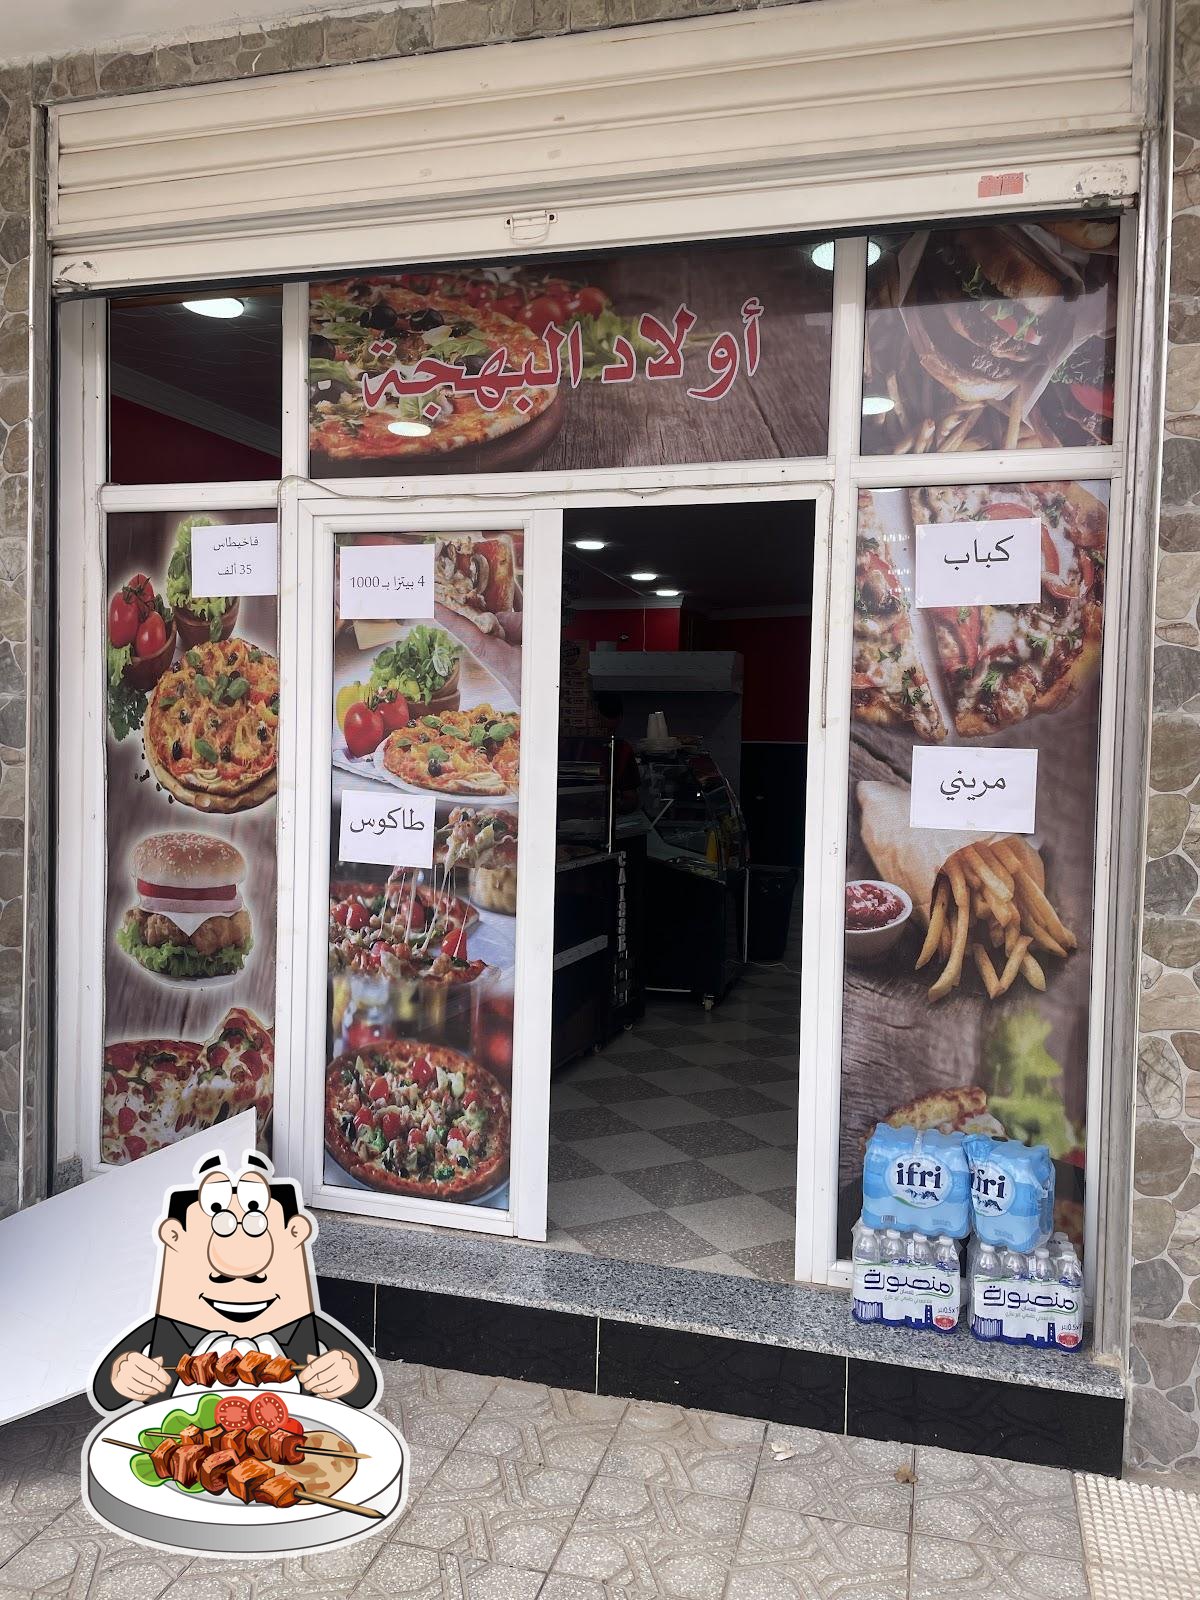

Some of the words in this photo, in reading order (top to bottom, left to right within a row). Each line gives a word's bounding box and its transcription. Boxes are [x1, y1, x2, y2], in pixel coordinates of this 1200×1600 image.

[602, 297, 765, 400] أولاد
[362, 321, 583, 419] البهجة
[943, 534, 1015, 571] كباب
[217, 562, 237, 576] ألف
[239, 564, 252, 575] 35
[350, 575, 380, 588] 1000
[417, 575, 425, 587] 4
[394, 575, 414, 591] بيتزا
[940, 769, 1007, 801] مريني
[349, 806, 425, 836] طاكوس
[896, 1162, 942, 1189] ifri
[863, 1269, 951, 1294] منصورة
[983, 1285, 1075, 1310] منصورة
